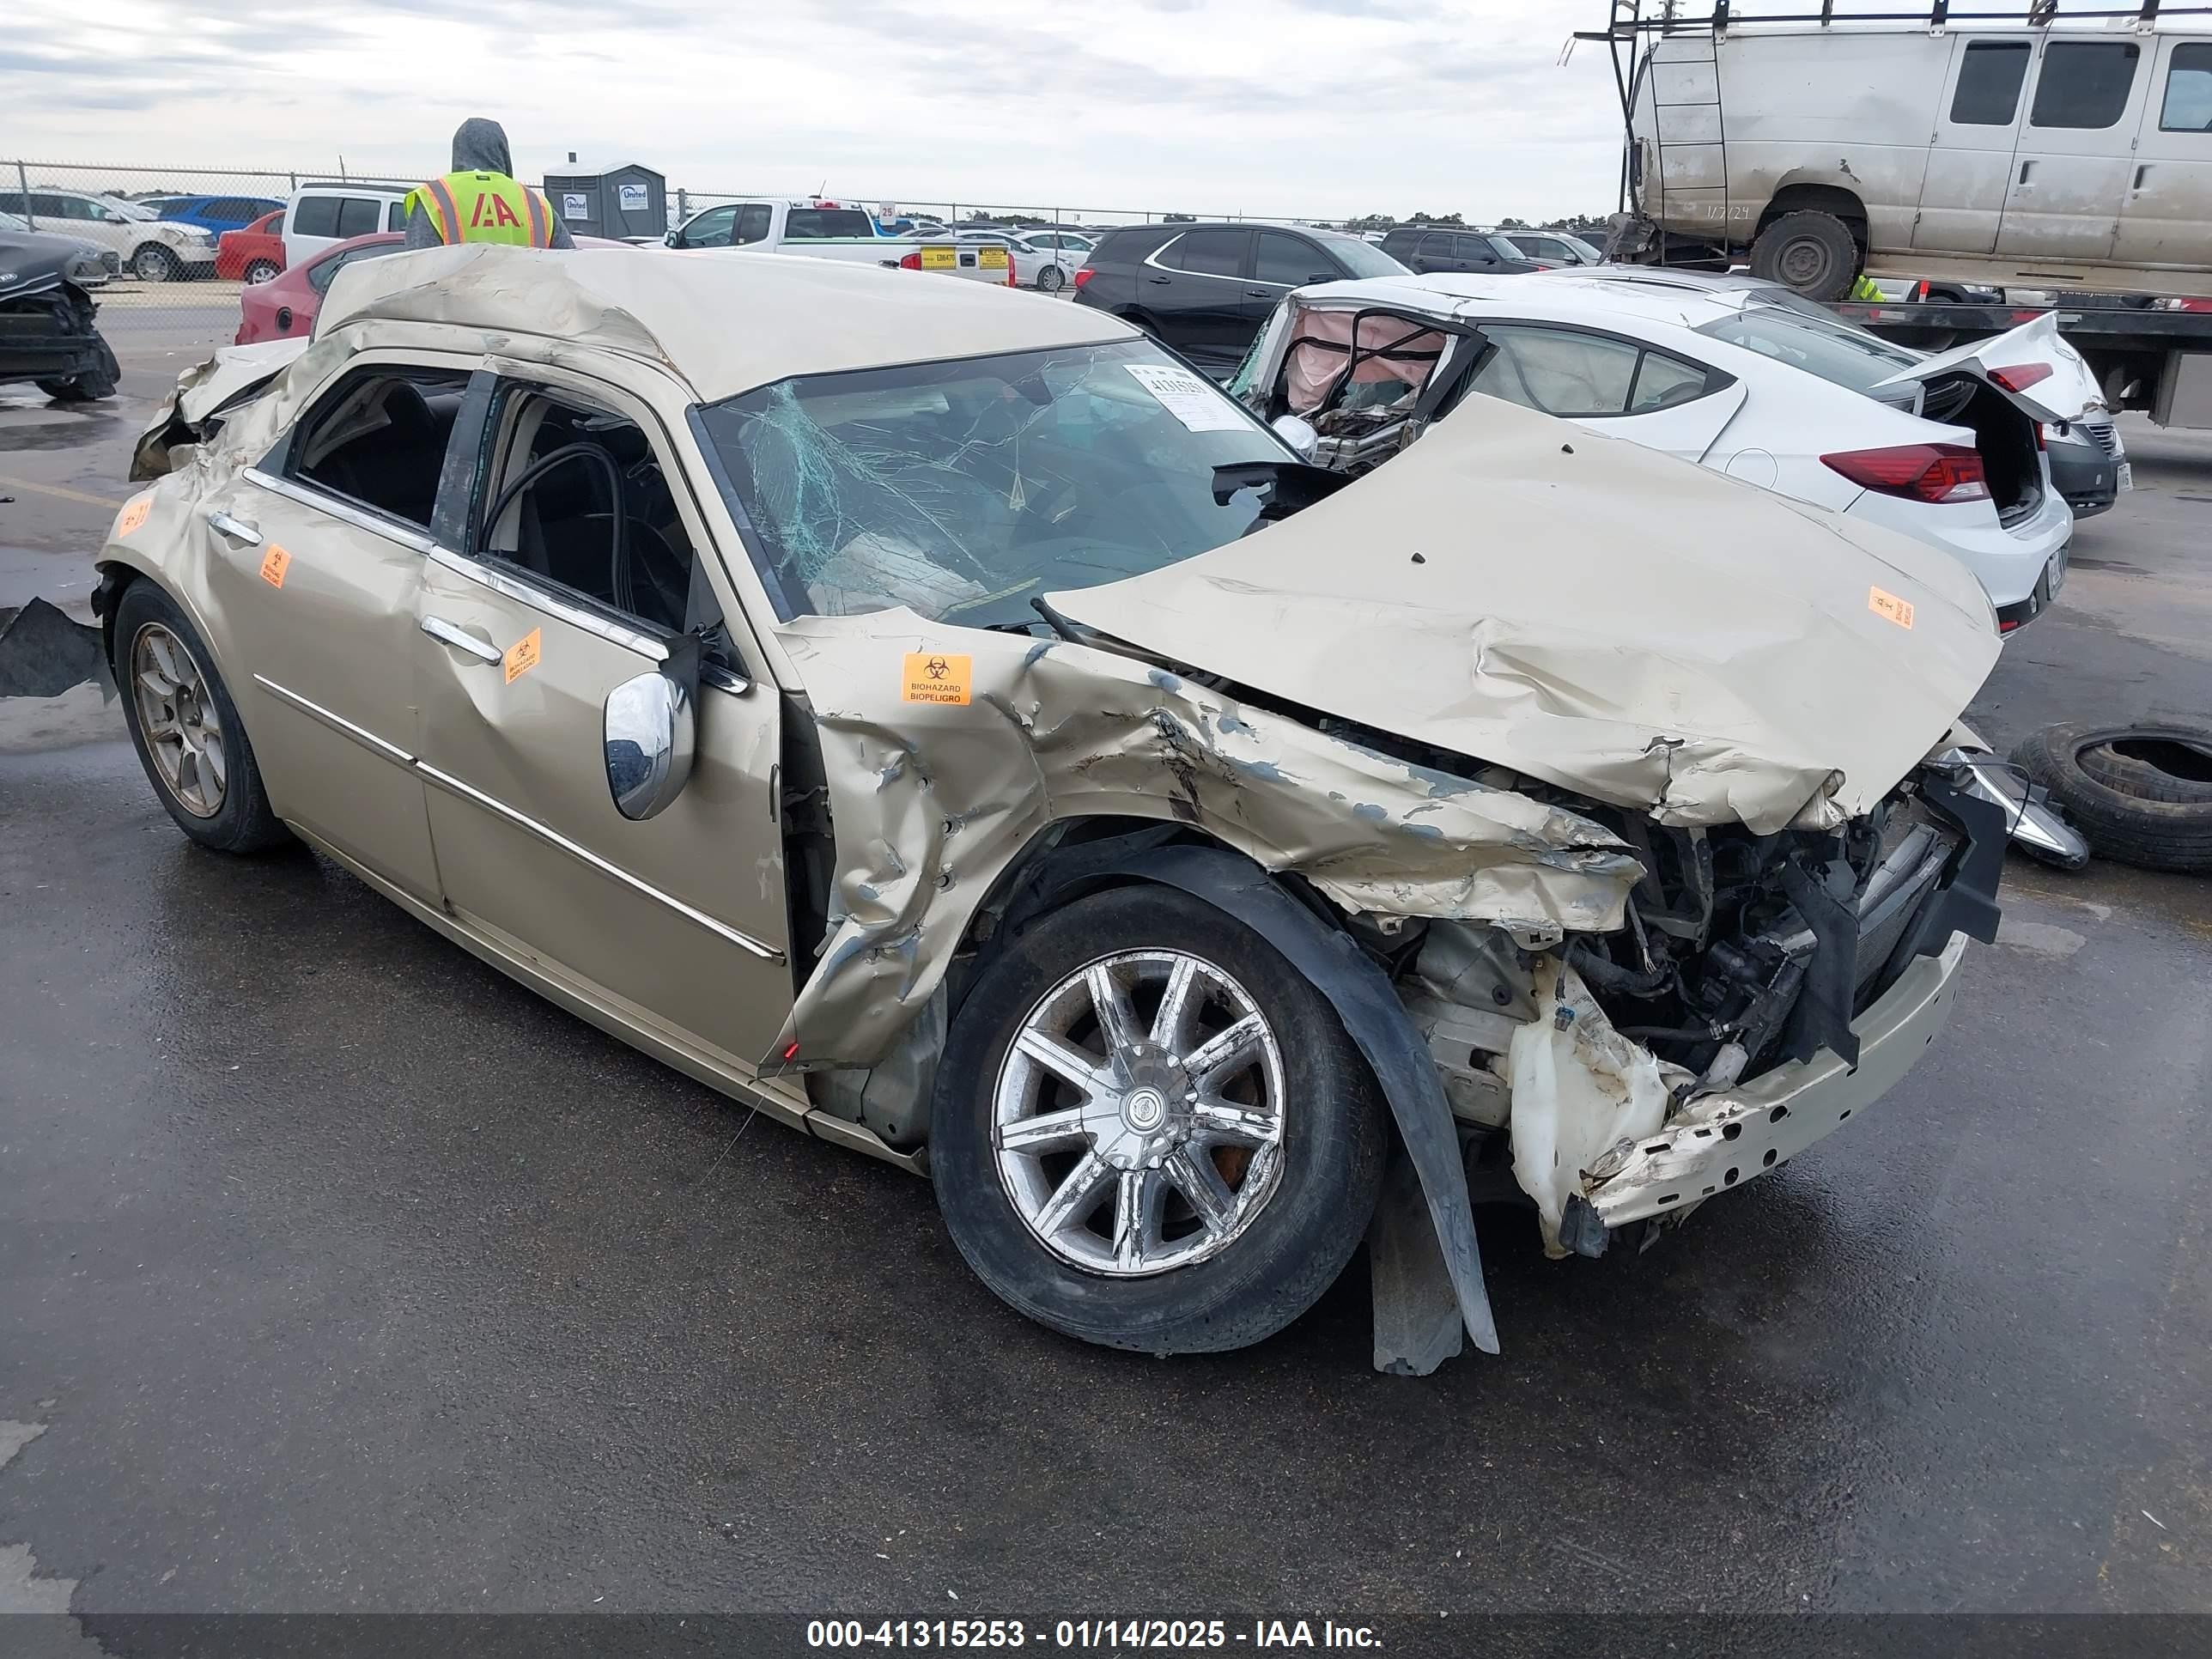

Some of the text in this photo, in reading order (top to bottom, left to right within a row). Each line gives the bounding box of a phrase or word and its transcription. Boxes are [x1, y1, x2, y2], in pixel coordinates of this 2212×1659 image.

[567, 201, 586, 210] United
[883, 208, 892, 216] 25
[1151, 380, 1207, 394] 41315253
[911, 683, 961, 693] BIOHAZARD
[910, 692, 961, 702] BIOPELIGRO
